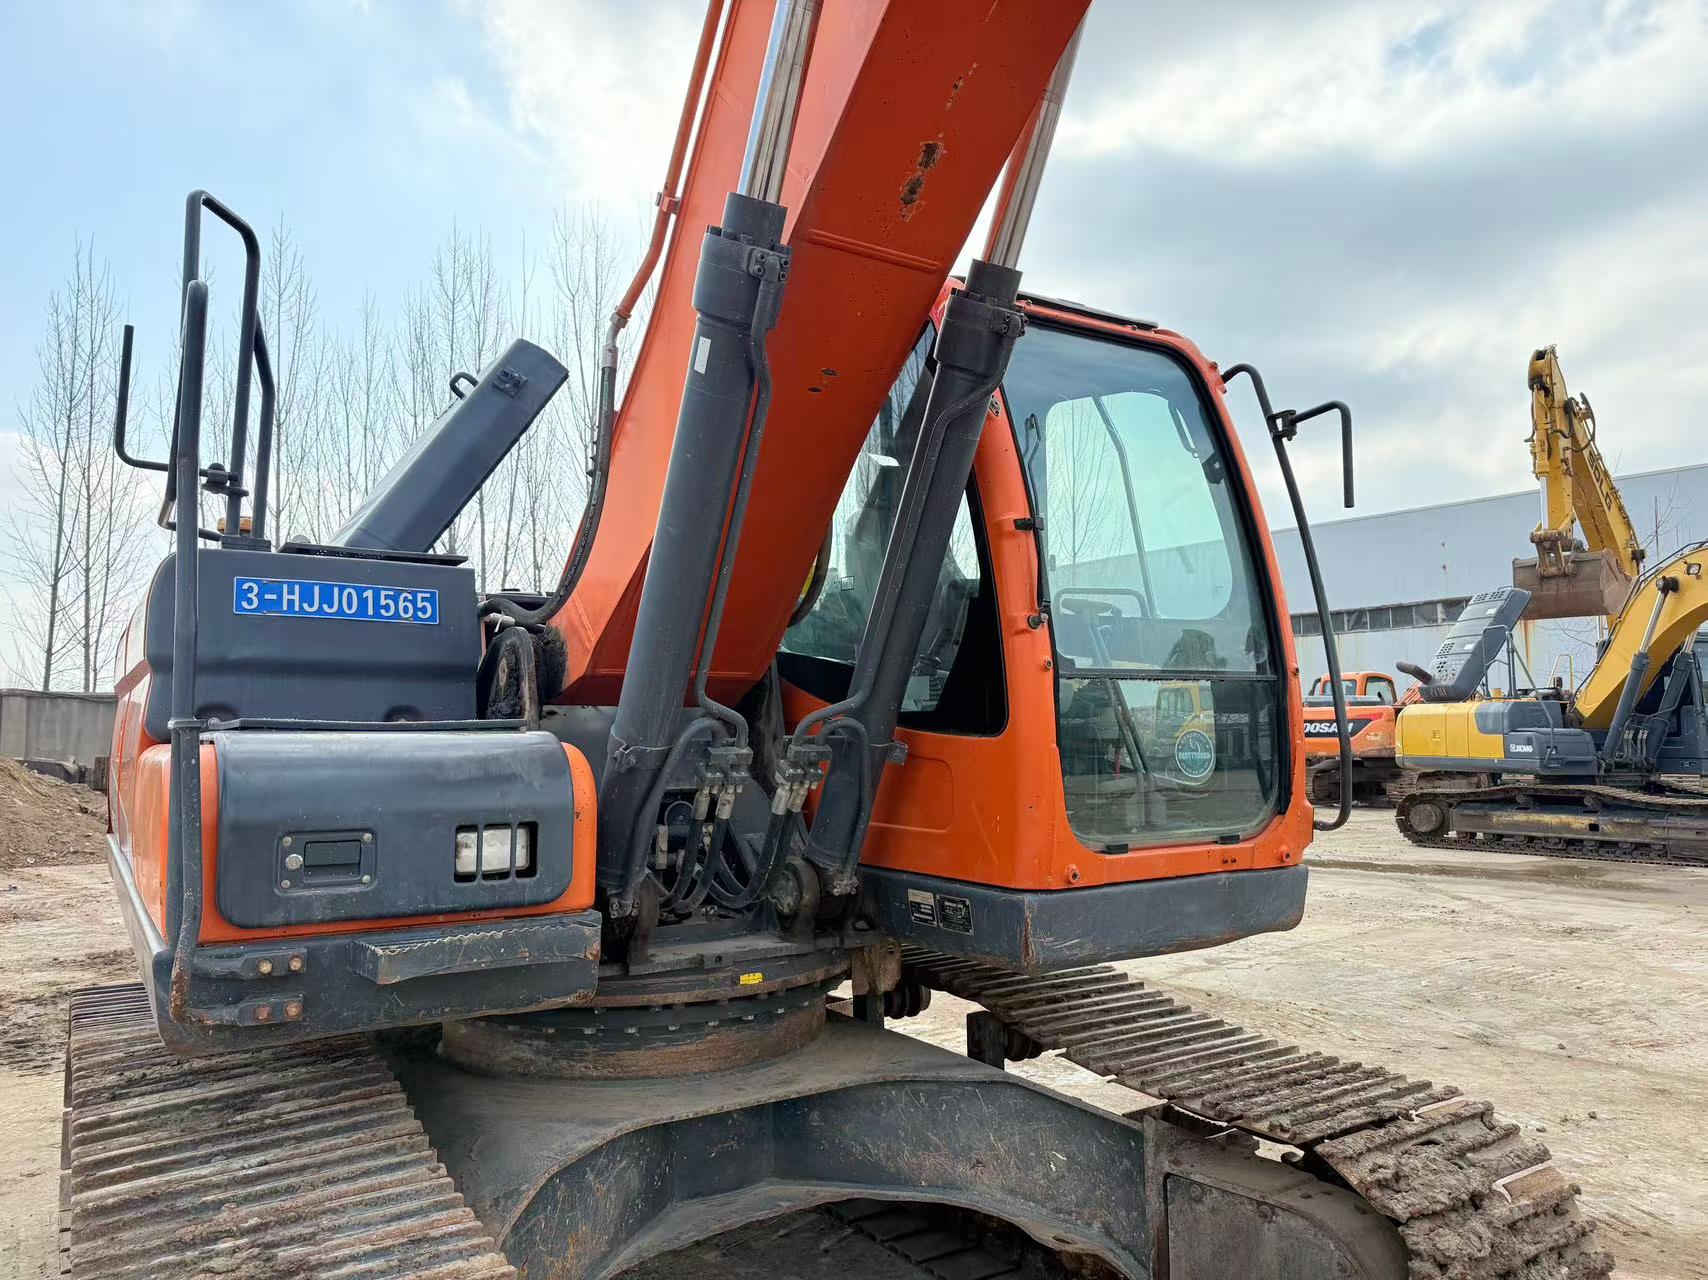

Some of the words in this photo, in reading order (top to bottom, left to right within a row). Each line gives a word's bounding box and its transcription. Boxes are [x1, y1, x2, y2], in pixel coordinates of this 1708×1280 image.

[1588, 450, 1612, 512] SDLG
[240, 581, 432, 619] 3-HJJ01565
[1304, 722, 1354, 733] OOSA
